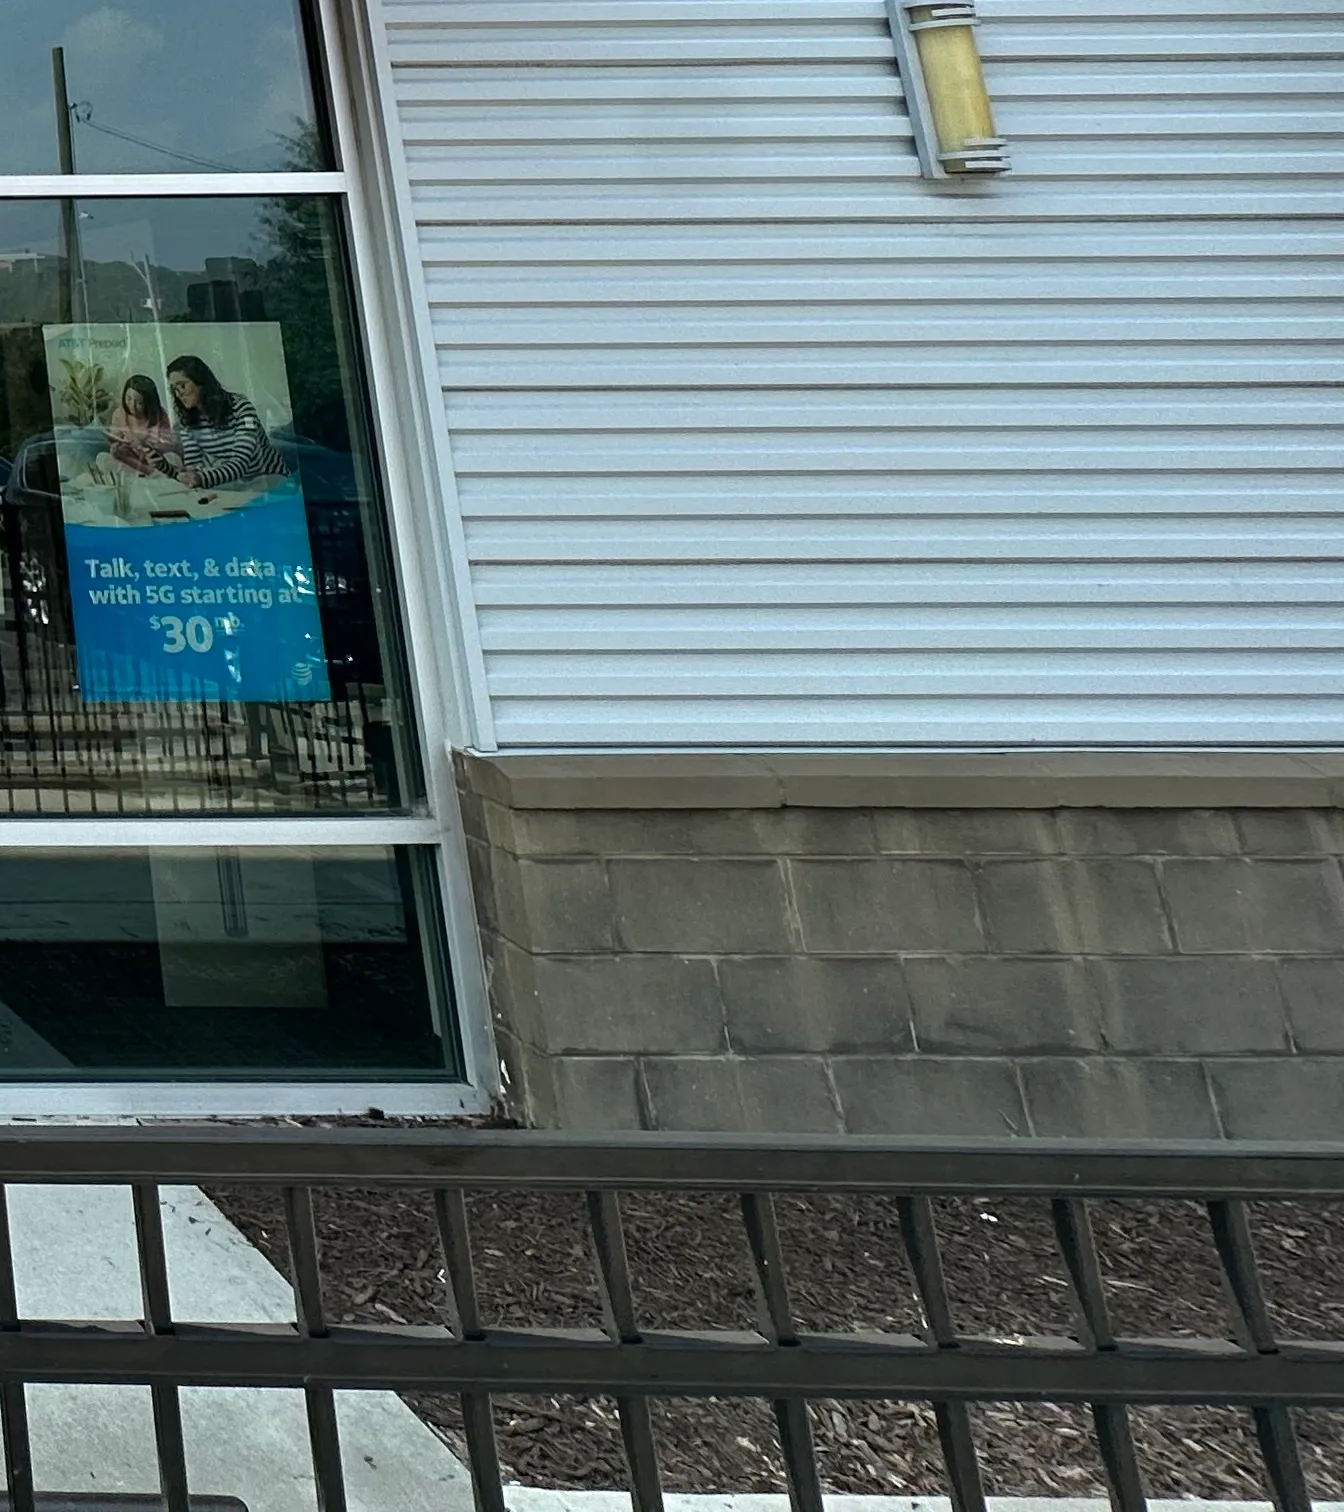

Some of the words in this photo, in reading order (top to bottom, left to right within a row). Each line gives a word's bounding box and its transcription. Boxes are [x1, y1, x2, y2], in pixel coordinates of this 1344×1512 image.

[85, 558, 140, 581] Talk,
[143, 559, 199, 581] text,
[204, 558, 220, 576] &
[224, 557, 276, 578] data
[89, 584, 141, 605] with
[146, 586, 175, 604] 5G
[180, 584, 273, 608] starting
[278, 586, 303, 604] at
[149, 614, 213, 654] $30
